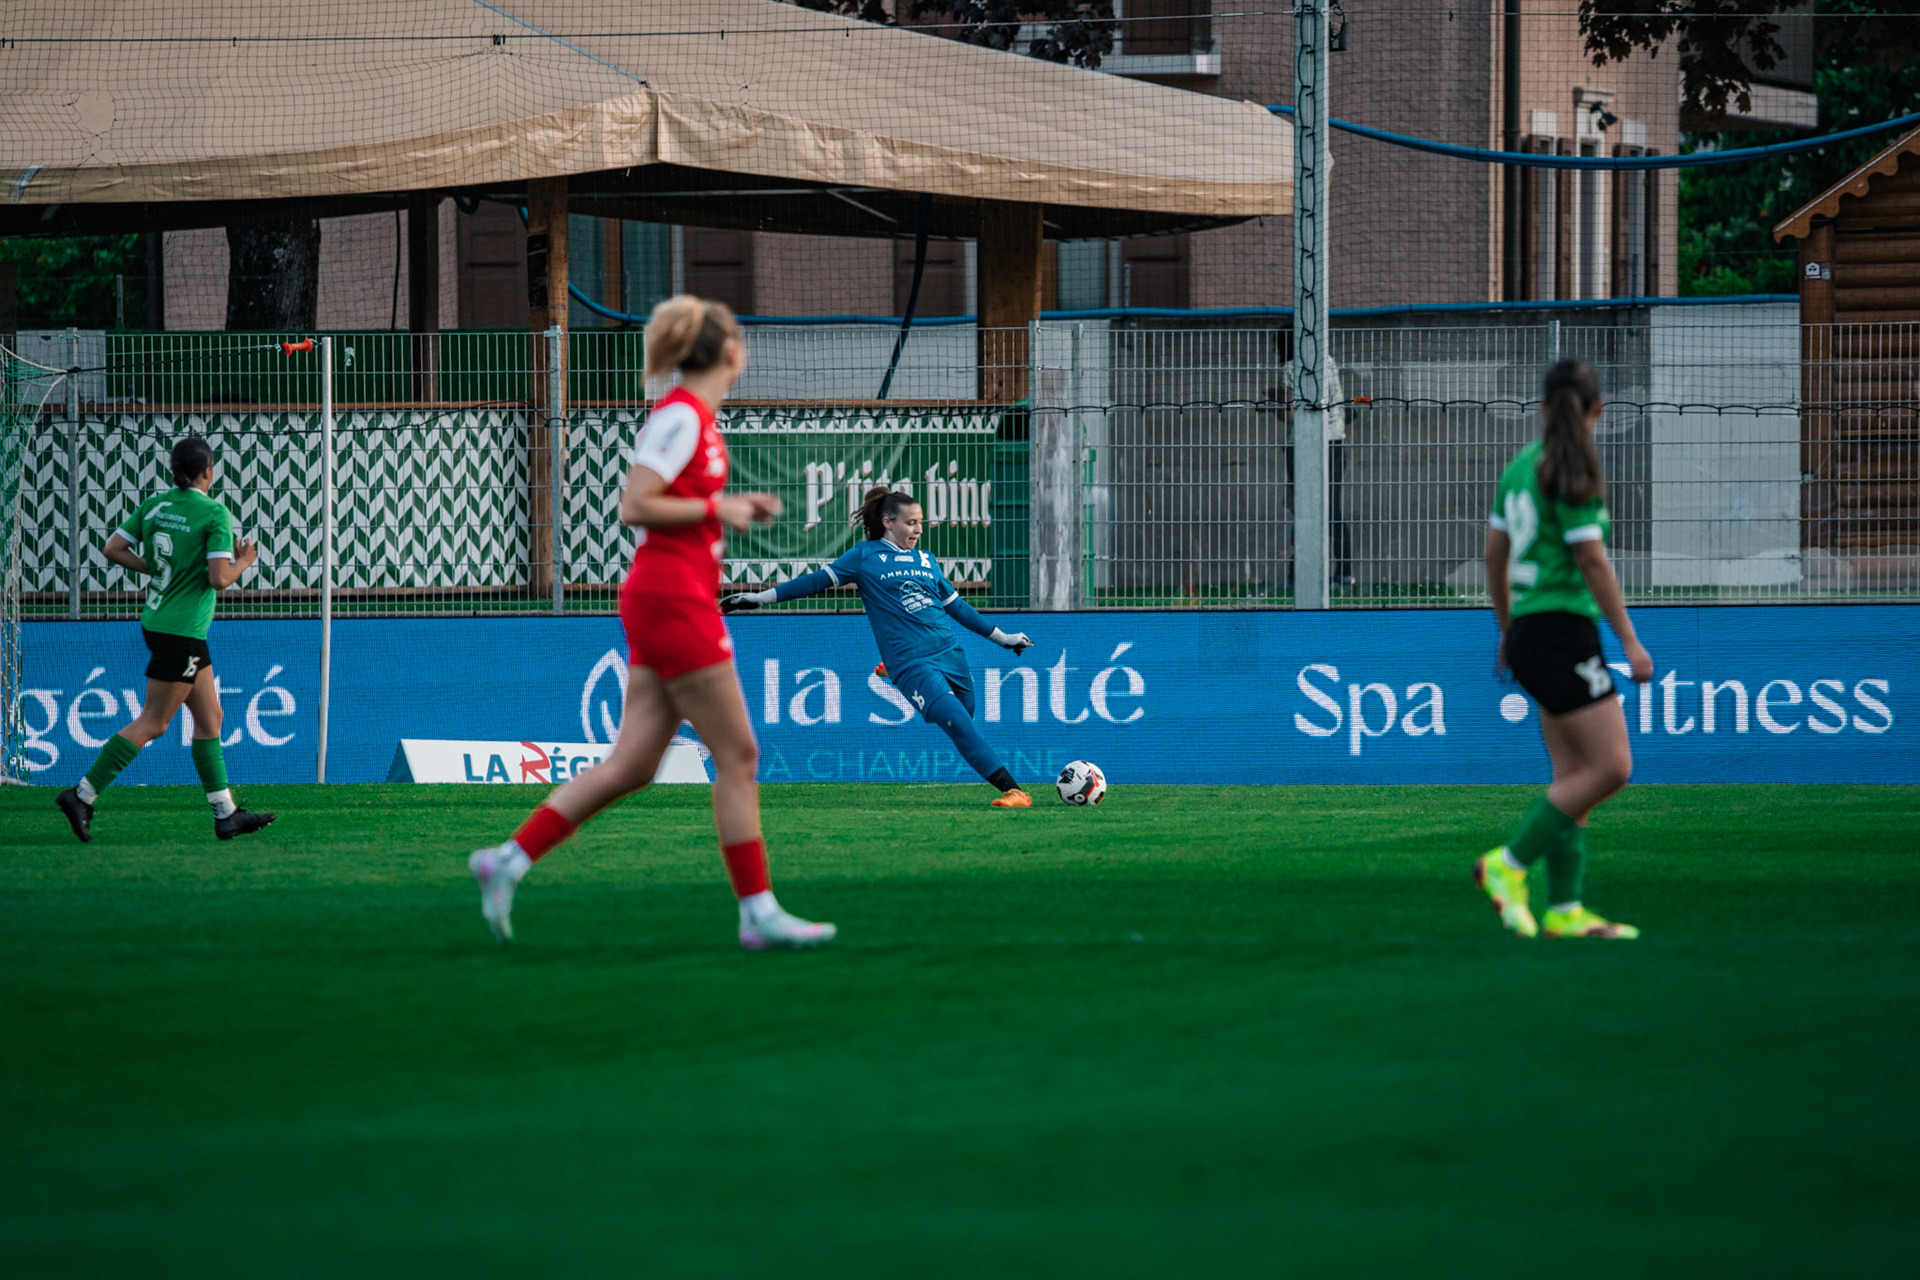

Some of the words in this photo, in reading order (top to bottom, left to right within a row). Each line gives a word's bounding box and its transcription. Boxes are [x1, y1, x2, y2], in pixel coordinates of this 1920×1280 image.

[763, 658, 842, 726] la
[868, 641, 1146, 725] snté
[1293, 663, 1447, 756] Spa
[1604, 662, 1893, 735] itness
[463, 753, 510, 783] LA
[519, 741, 603, 784] RÉG
[807, 750, 1069, 780] CHAMPNE
